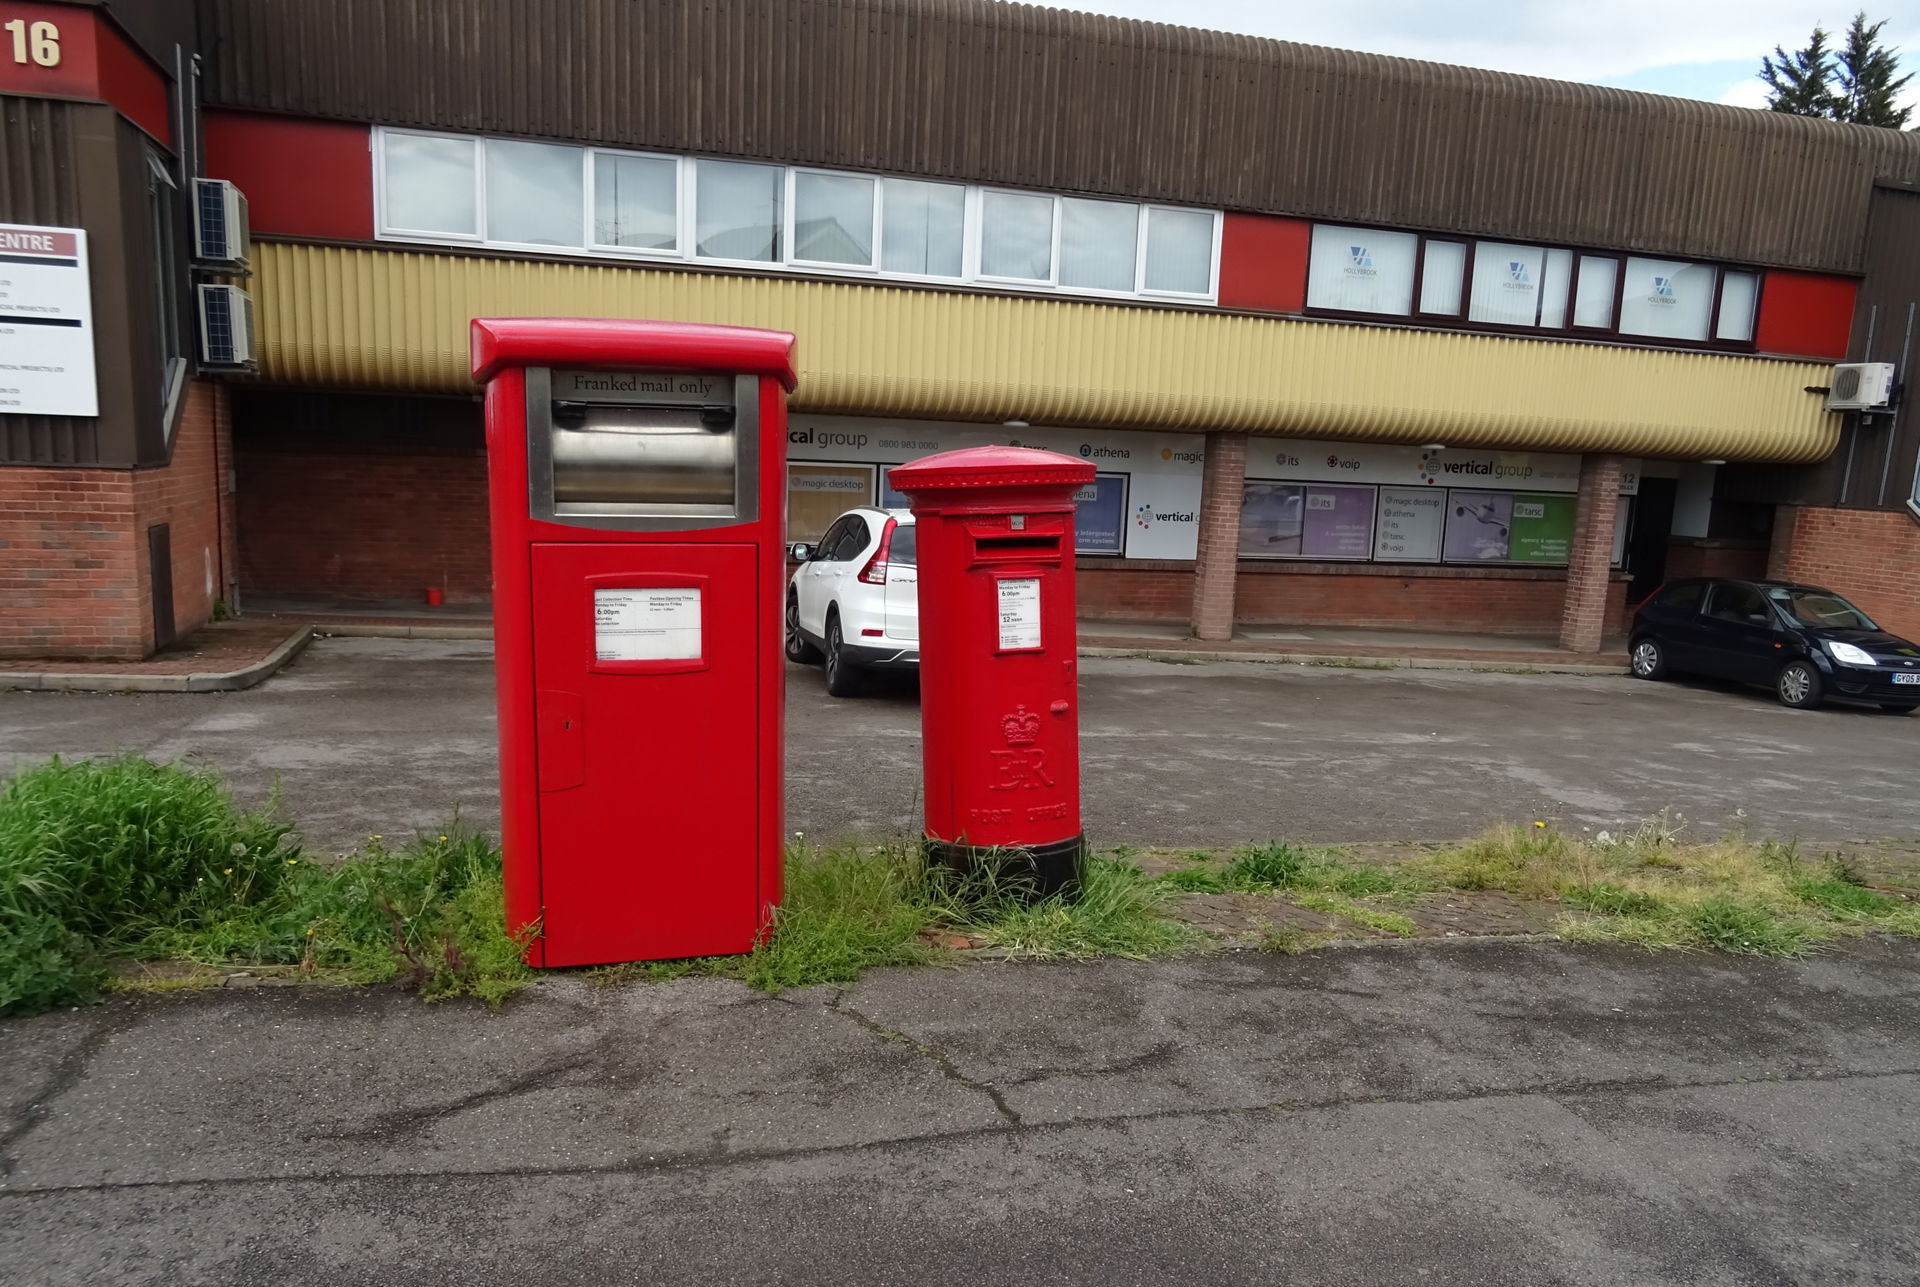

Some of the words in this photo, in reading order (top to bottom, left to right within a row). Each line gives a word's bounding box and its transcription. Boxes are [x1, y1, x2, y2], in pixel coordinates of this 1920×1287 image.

[5, 19, 60, 67] 16
[574, 375, 637, 391] Franked
[641, 377, 674, 393] mail
[679, 379, 712, 397] only
[817, 432, 868, 449] group
[879, 440, 899, 449] 0800
[901, 440, 916, 449] 983
[919, 441, 939, 450] 0000
[1093, 446, 1130, 459] athena
[1173, 451, 1204, 464] magic
[1287, 455, 1300, 466] its
[1339, 457, 1361, 472] voip
[1443, 460, 1493, 476] vertical
[1495, 463, 1533, 479] group
[1621, 472, 1635, 483] 12
[802, 480, 828, 490] magic
[829, 479, 864, 490] desktop
[1320, 498, 1331, 508] its
[1413, 498, 1440, 508] desktop
[1155, 511, 1194, 523] vertical
[1392, 510, 1416, 518] athena
[1524, 507, 1542, 516] tarsc
[597, 608, 620, 616] 6.00pm
[1897, 674, 1914, 683] GY05
[970, 808, 1012, 824] POST
